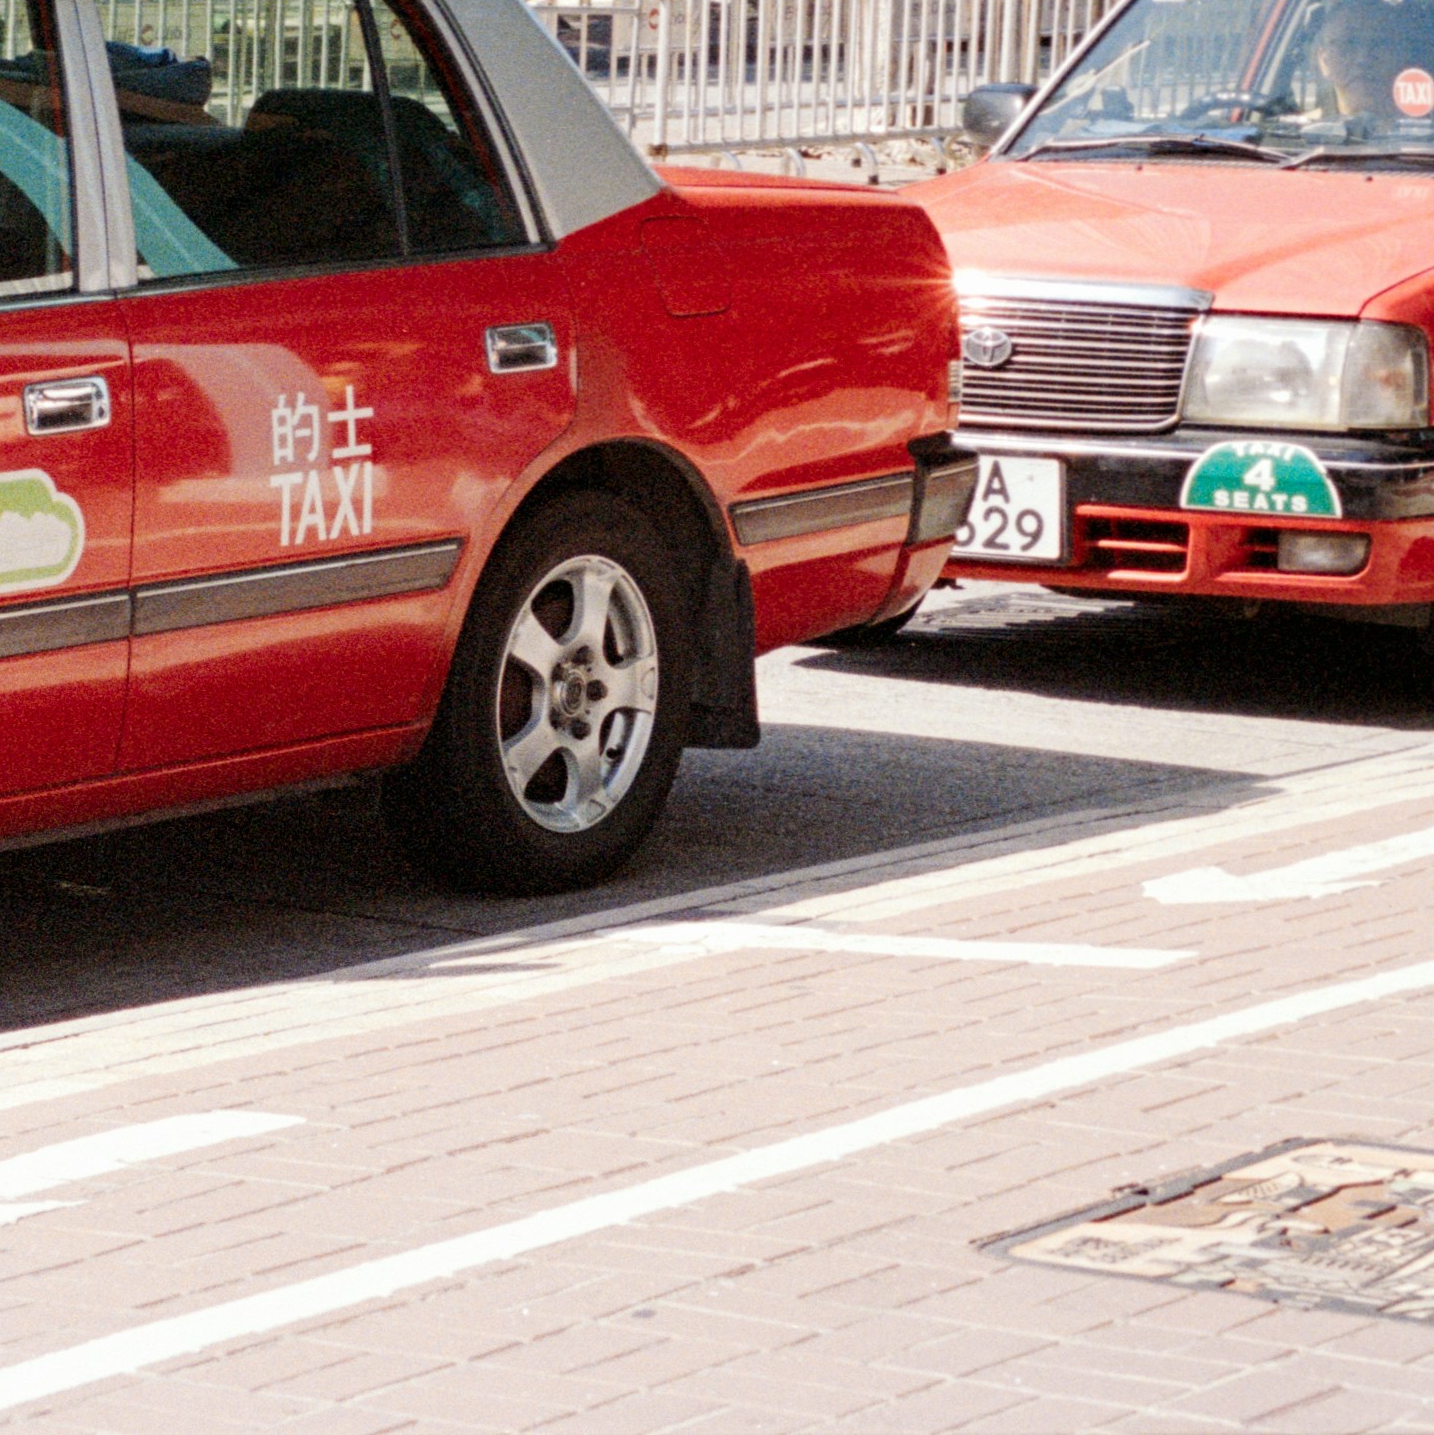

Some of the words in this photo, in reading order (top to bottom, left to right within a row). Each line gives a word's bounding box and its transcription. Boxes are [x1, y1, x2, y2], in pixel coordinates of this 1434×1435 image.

[1396, 81, 1431, 105] TAXI
[271, 385, 374, 466] 的士
[1232, 442, 1298, 461] TAXI
[982, 459, 1010, 504] A
[1243, 458, 1276, 492] 4
[269, 461, 373, 547] TAXI
[1214, 489, 1308, 513] SEATS
[953, 506, 1044, 553] 29
